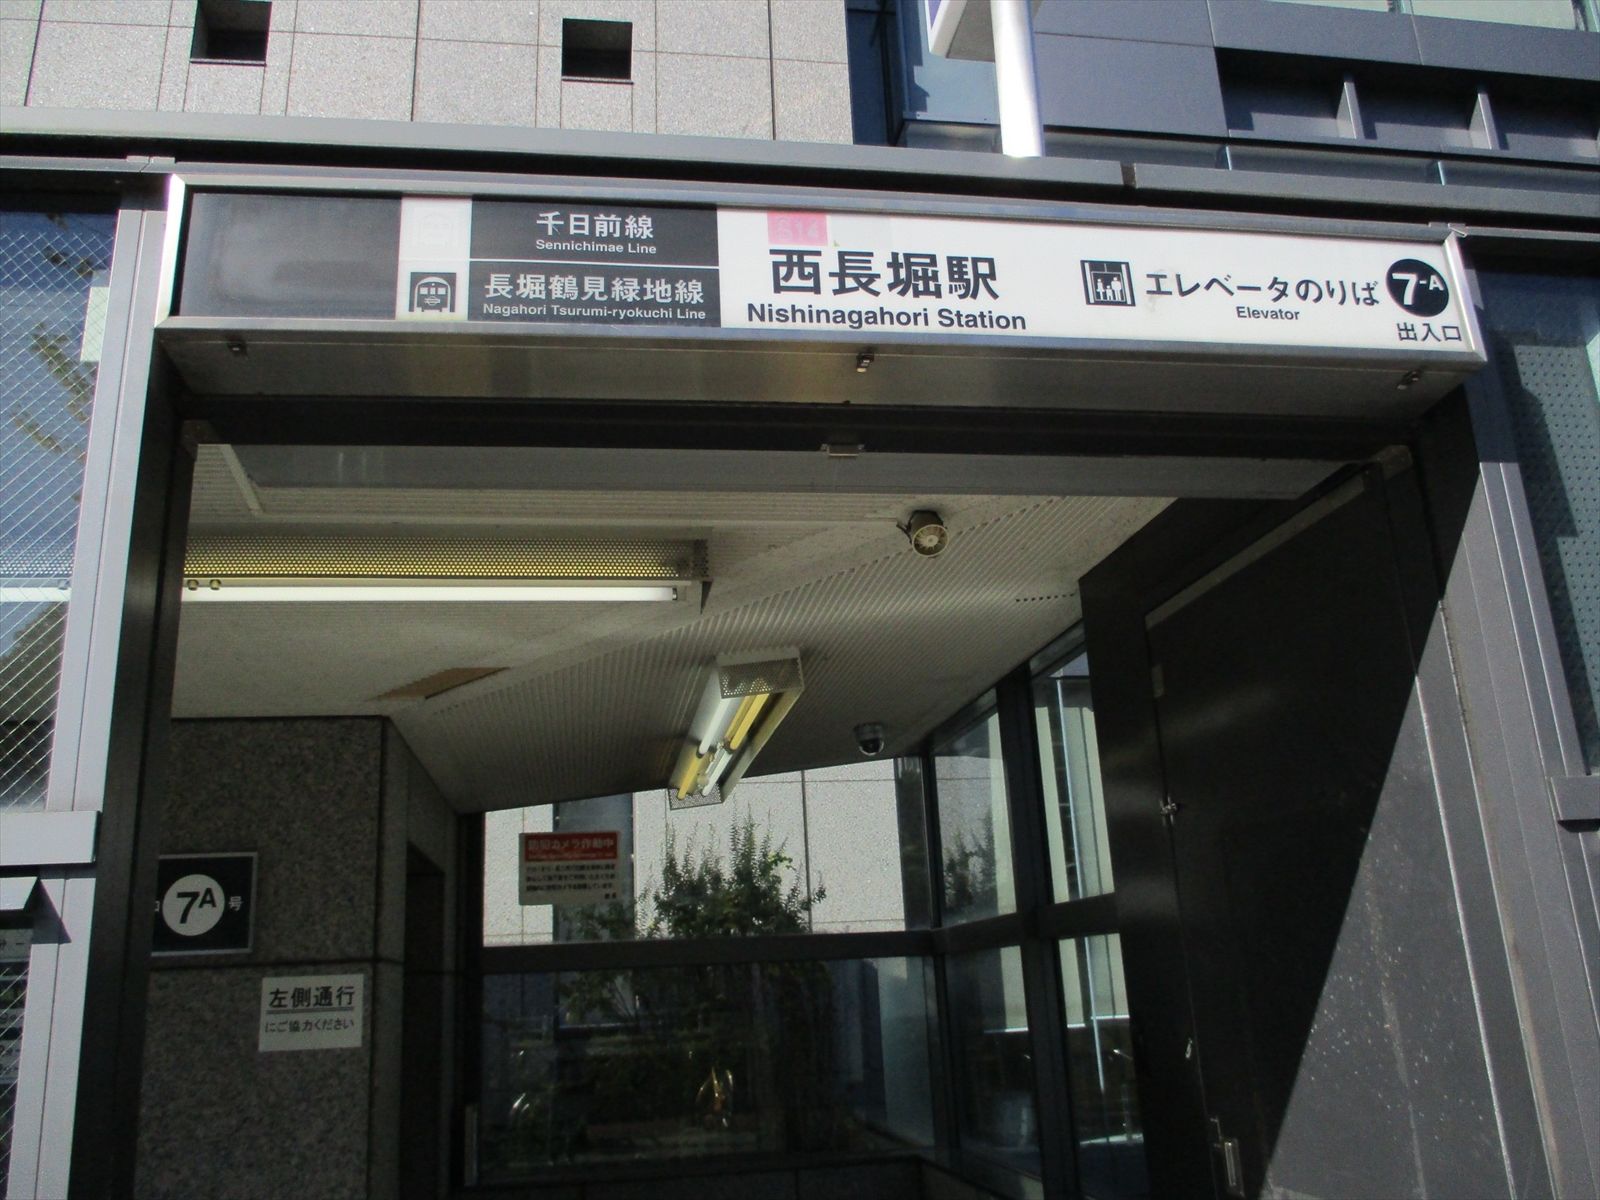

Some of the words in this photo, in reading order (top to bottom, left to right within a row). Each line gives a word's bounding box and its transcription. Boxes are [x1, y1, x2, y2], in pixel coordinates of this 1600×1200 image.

[536, 211, 654, 239] 千日前線
[535, 239, 624, 254] Sennichimae
[627, 243, 657, 255] Line
[769, 248, 1000, 300] 西長堀駅
[484, 273, 704, 305] 長堀鶴見緑地線
[1145, 273, 1380, 307] エレベータのりば
[483, 303, 547, 317] Nagahori
[551, 305, 673, 320] Tsurumi-ryokuchi
[676, 308, 706, 320] Line
[747, 303, 929, 330] Nishinagahori
[937, 308, 1027, 330] Station
[1235, 305, 1300, 321] Elevator
[1396, 321, 1463, 343] 出入口
[268, 986, 355, 1009] 左側通行
[264, 1018, 355, 1033] にご協力ください
